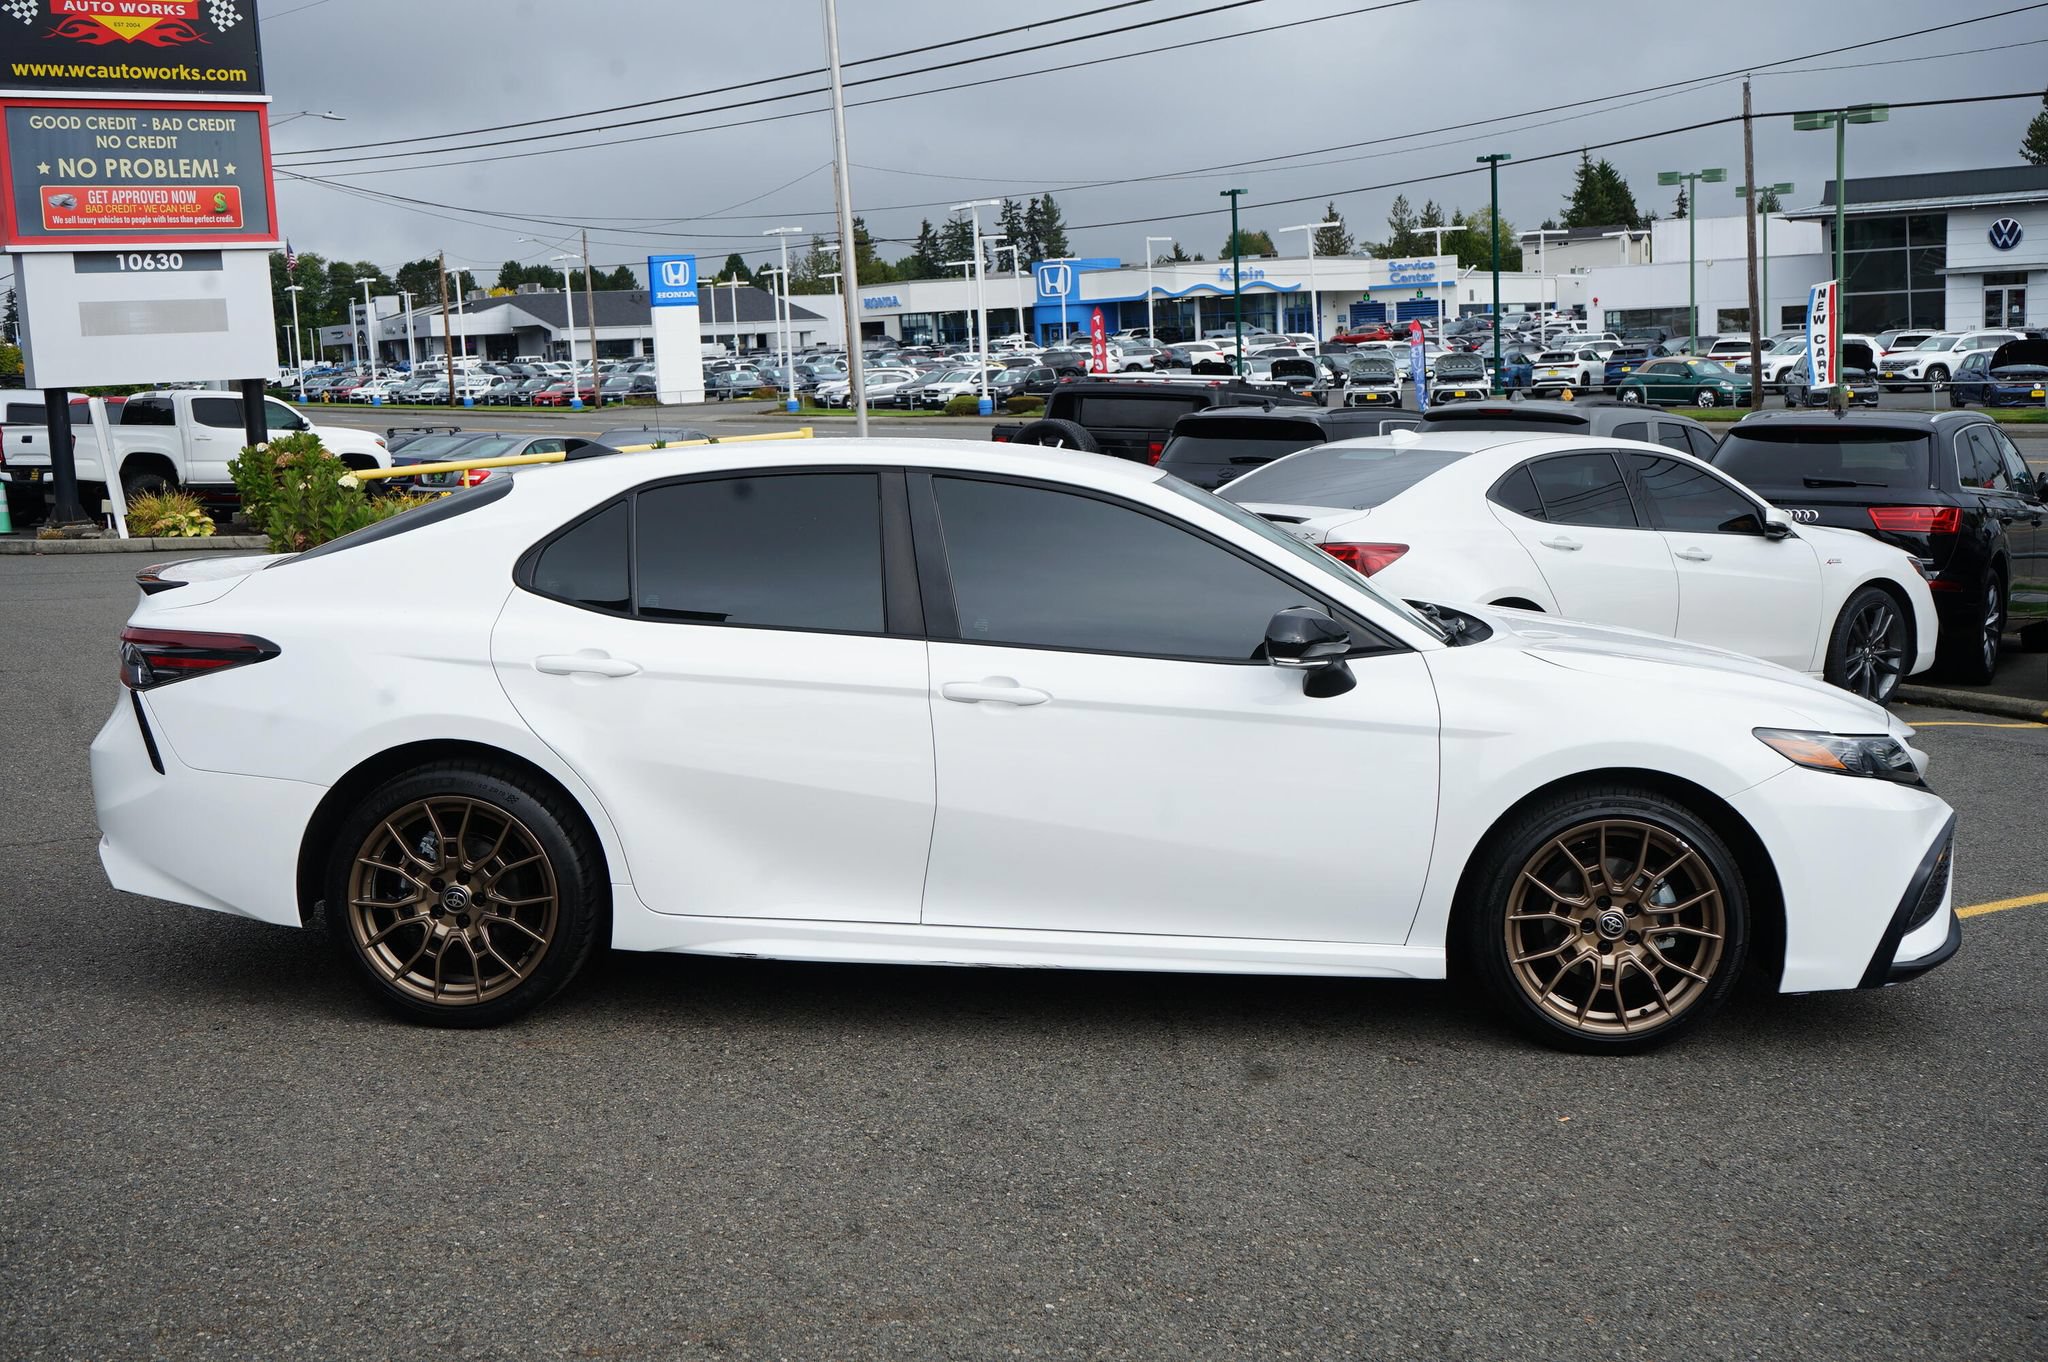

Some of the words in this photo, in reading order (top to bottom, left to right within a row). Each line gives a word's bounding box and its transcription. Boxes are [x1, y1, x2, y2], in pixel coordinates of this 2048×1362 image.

[63, 0, 115, 13] AUTO
[120, 2, 186, 16] WORKS
[11, 63, 247, 82] www.wcautoworks.com
[29, 115, 81, 130] GOOD
[85, 116, 137, 131] CREDIT
[152, 117, 183, 131] BAD
[187, 118, 236, 132] CREDIT
[96, 135, 121, 148] NO
[126, 135, 177, 149] CREDIT
[58, 158, 97, 178] NO
[105, 158, 219, 178] PROBLEM!
[87, 190, 108, 204] GET
[111, 190, 168, 204] APPROVED
[171, 190, 196, 204] NOW
[85, 204, 104, 213] BAD
[105, 204, 137, 213] CREDIT
[143, 204, 158, 213] WE
[159, 204, 178, 213] CAN
[179, 204, 202, 213] HELP
[52, 216, 64, 224] We
[64, 216, 76, 224] sell
[77, 216, 97, 225] luxury
[98, 216, 124, 224] vehicles
[124, 216, 131, 224] to
[131, 216, 152, 225] people
[153, 215, 166, 223] with
[167, 215, 179, 223] less
[180, 215, 194, 223] than
[194, 215, 215, 224] perfect
[215, 215, 235, 223] credit.
[116, 253, 183, 270] 10630
[1388, 259, 1436, 271] Service
[1219, 266, 1265, 282] Kein
[1390, 272, 1436, 283] Center
[656, 291, 696, 299] HONDA
[1813, 288, 1826, 325] NEW
[1814, 334, 1826, 382] CARS
